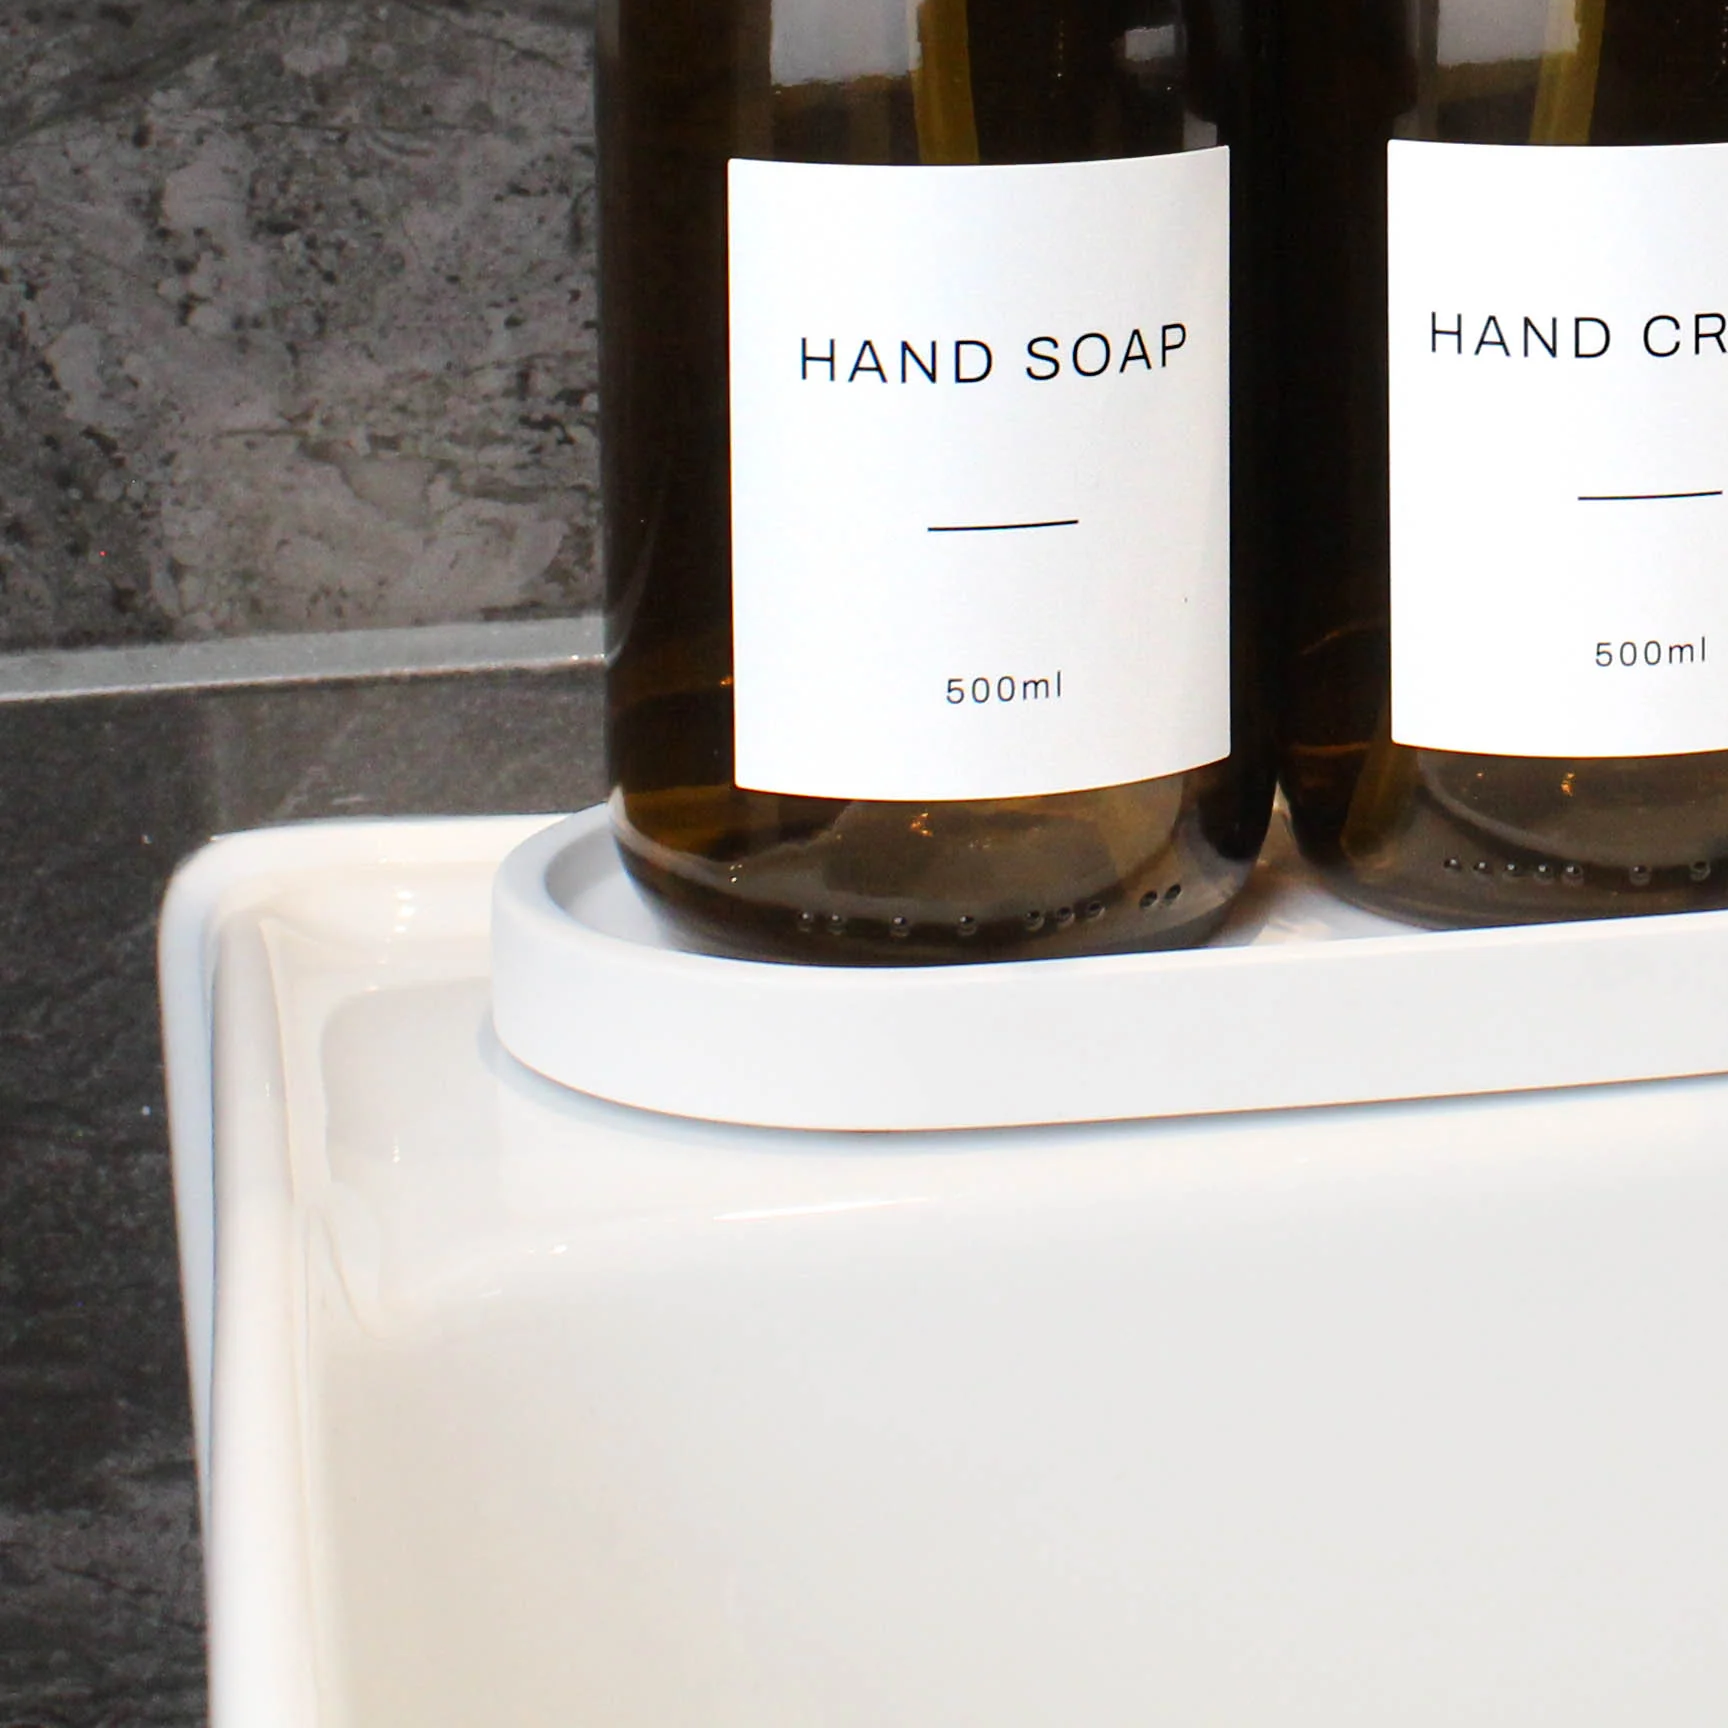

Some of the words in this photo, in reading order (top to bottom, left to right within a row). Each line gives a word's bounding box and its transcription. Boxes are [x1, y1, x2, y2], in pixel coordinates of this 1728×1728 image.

[800, 336, 994, 386] HAND
[1024, 321, 1188, 382] SOAP
[1430, 310, 1612, 360] HAND
[1594, 635, 1707, 668] 500ml
[945, 669, 1062, 706] 500ml
